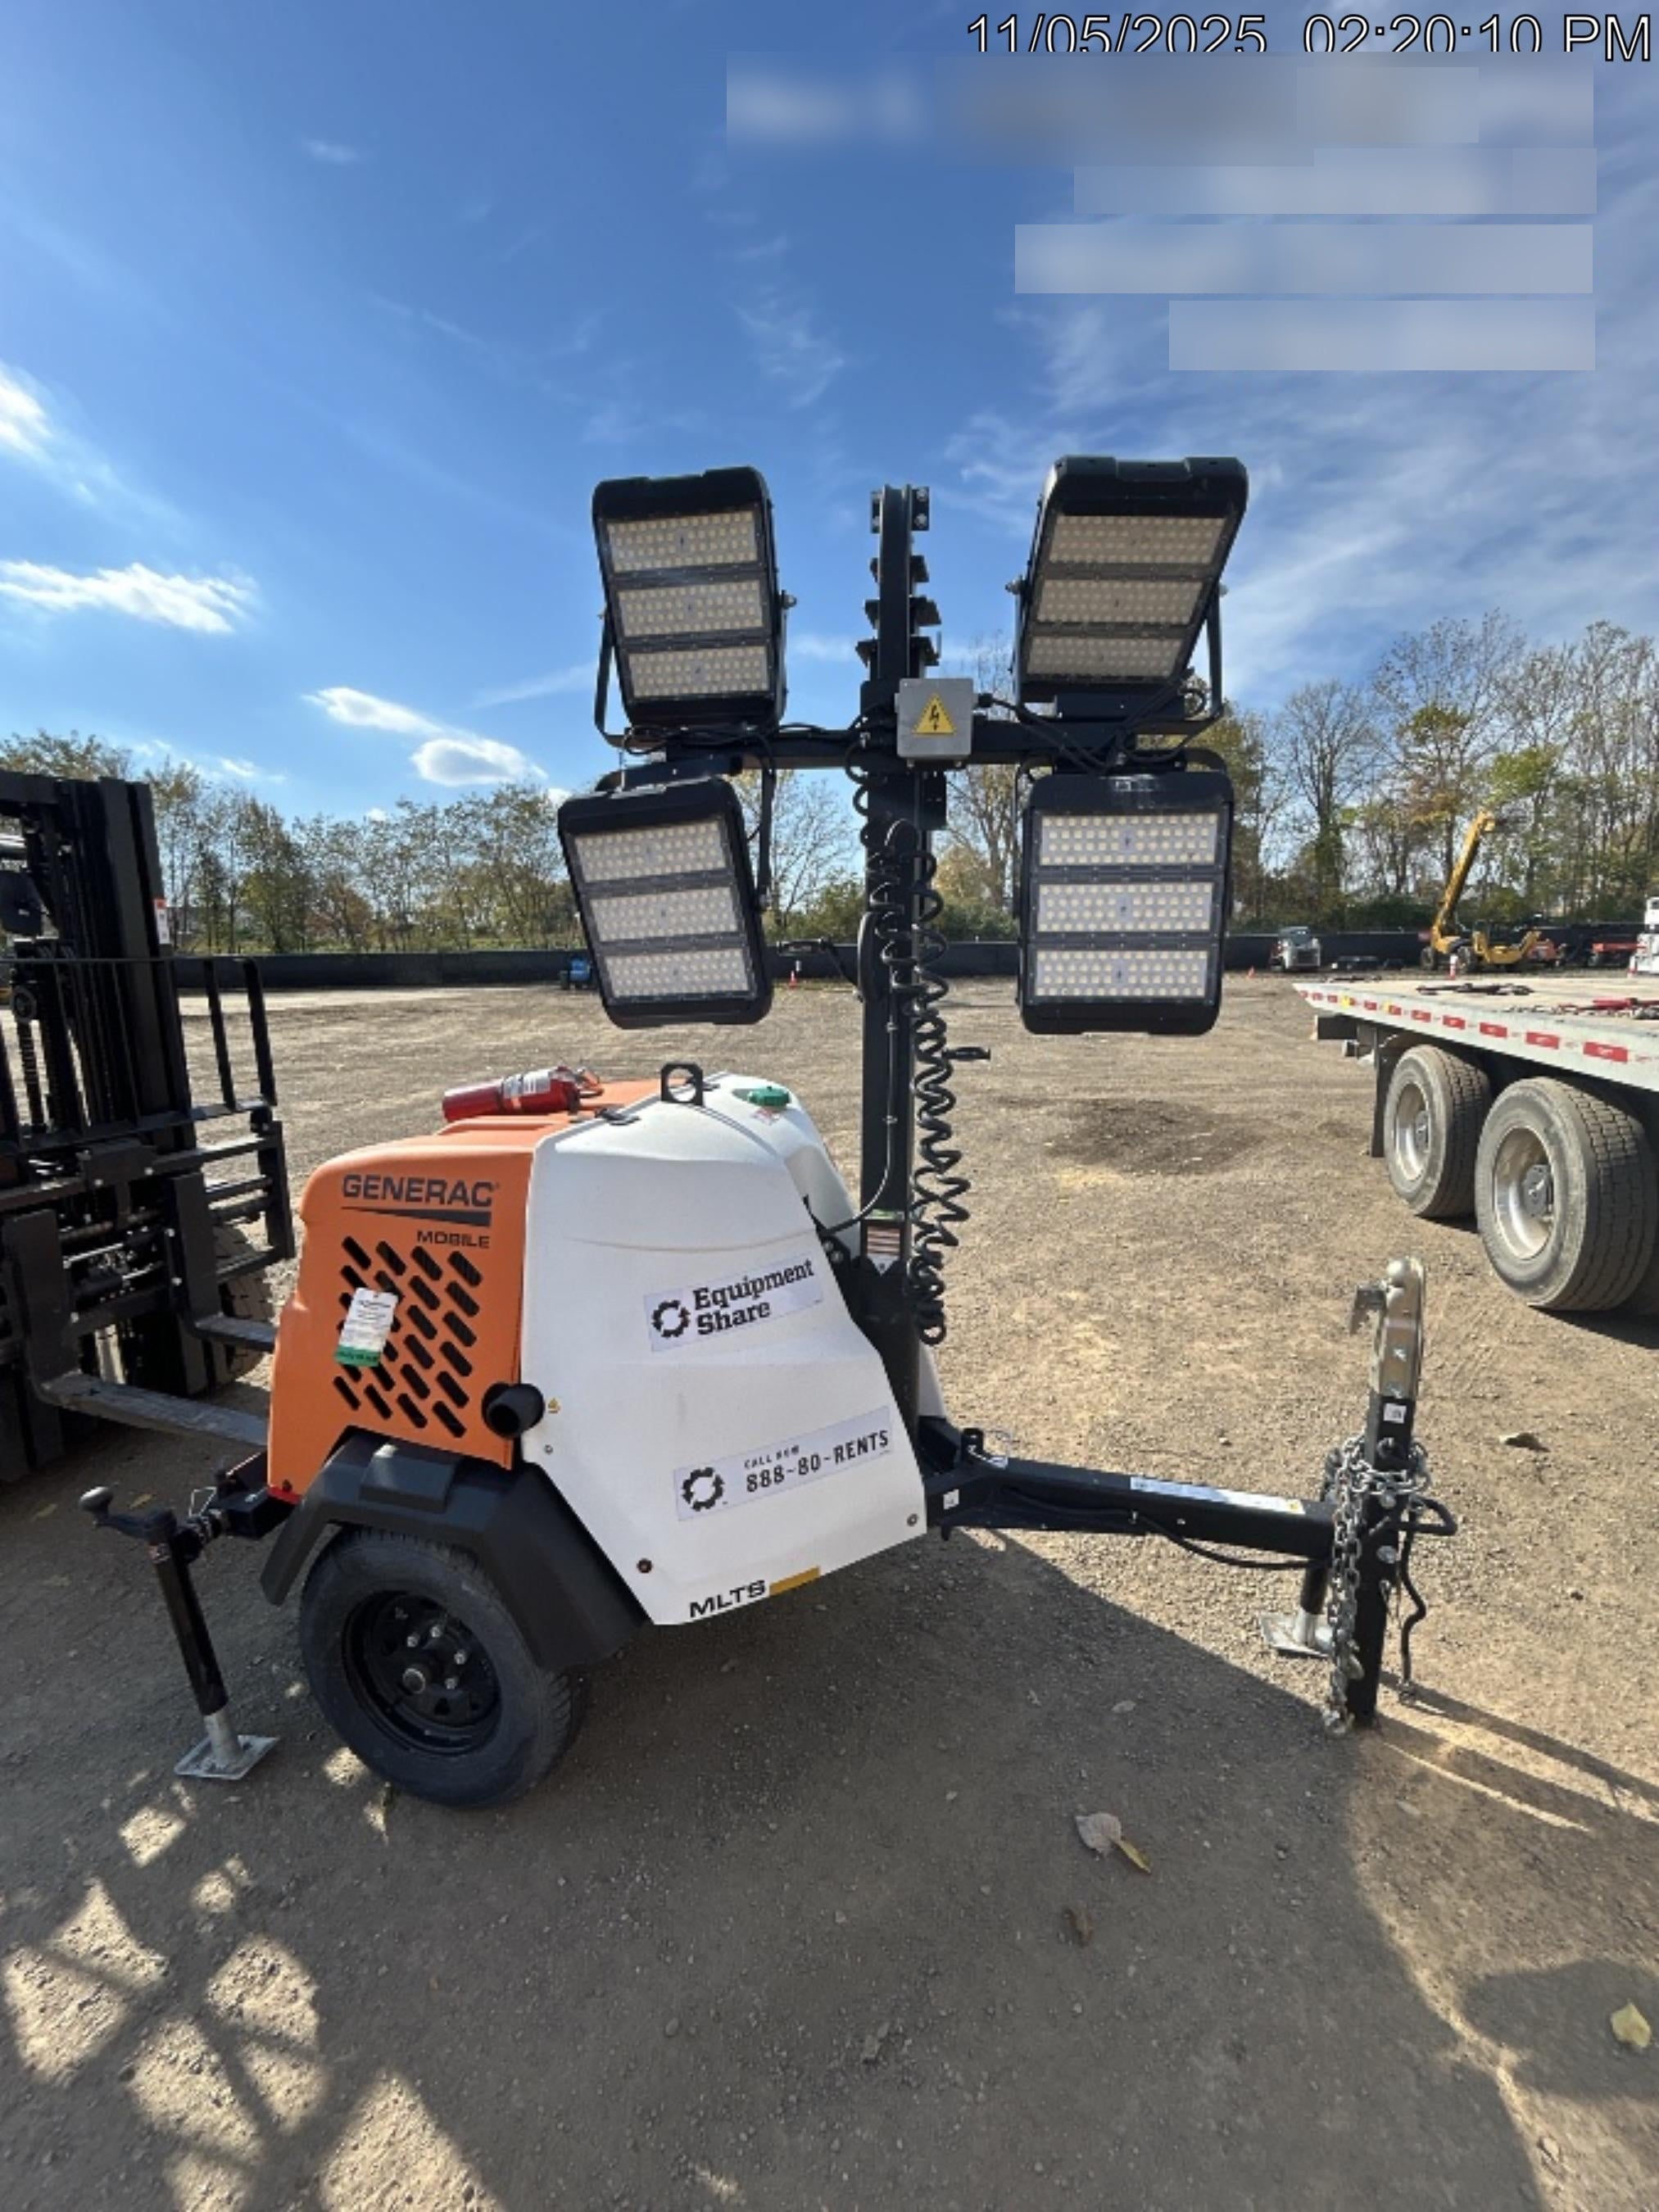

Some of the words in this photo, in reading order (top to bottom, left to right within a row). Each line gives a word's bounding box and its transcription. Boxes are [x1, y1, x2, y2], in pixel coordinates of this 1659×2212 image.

[342, 1174, 493, 1207] GENERAC
[417, 1231, 490, 1249] MOBILE
[692, 1258, 814, 1310] Equipment
[697, 1302, 771, 1335] Share
[744, 1455, 772, 1470] CALL
[746, 1430, 888, 1493] 888-80-RENTS
